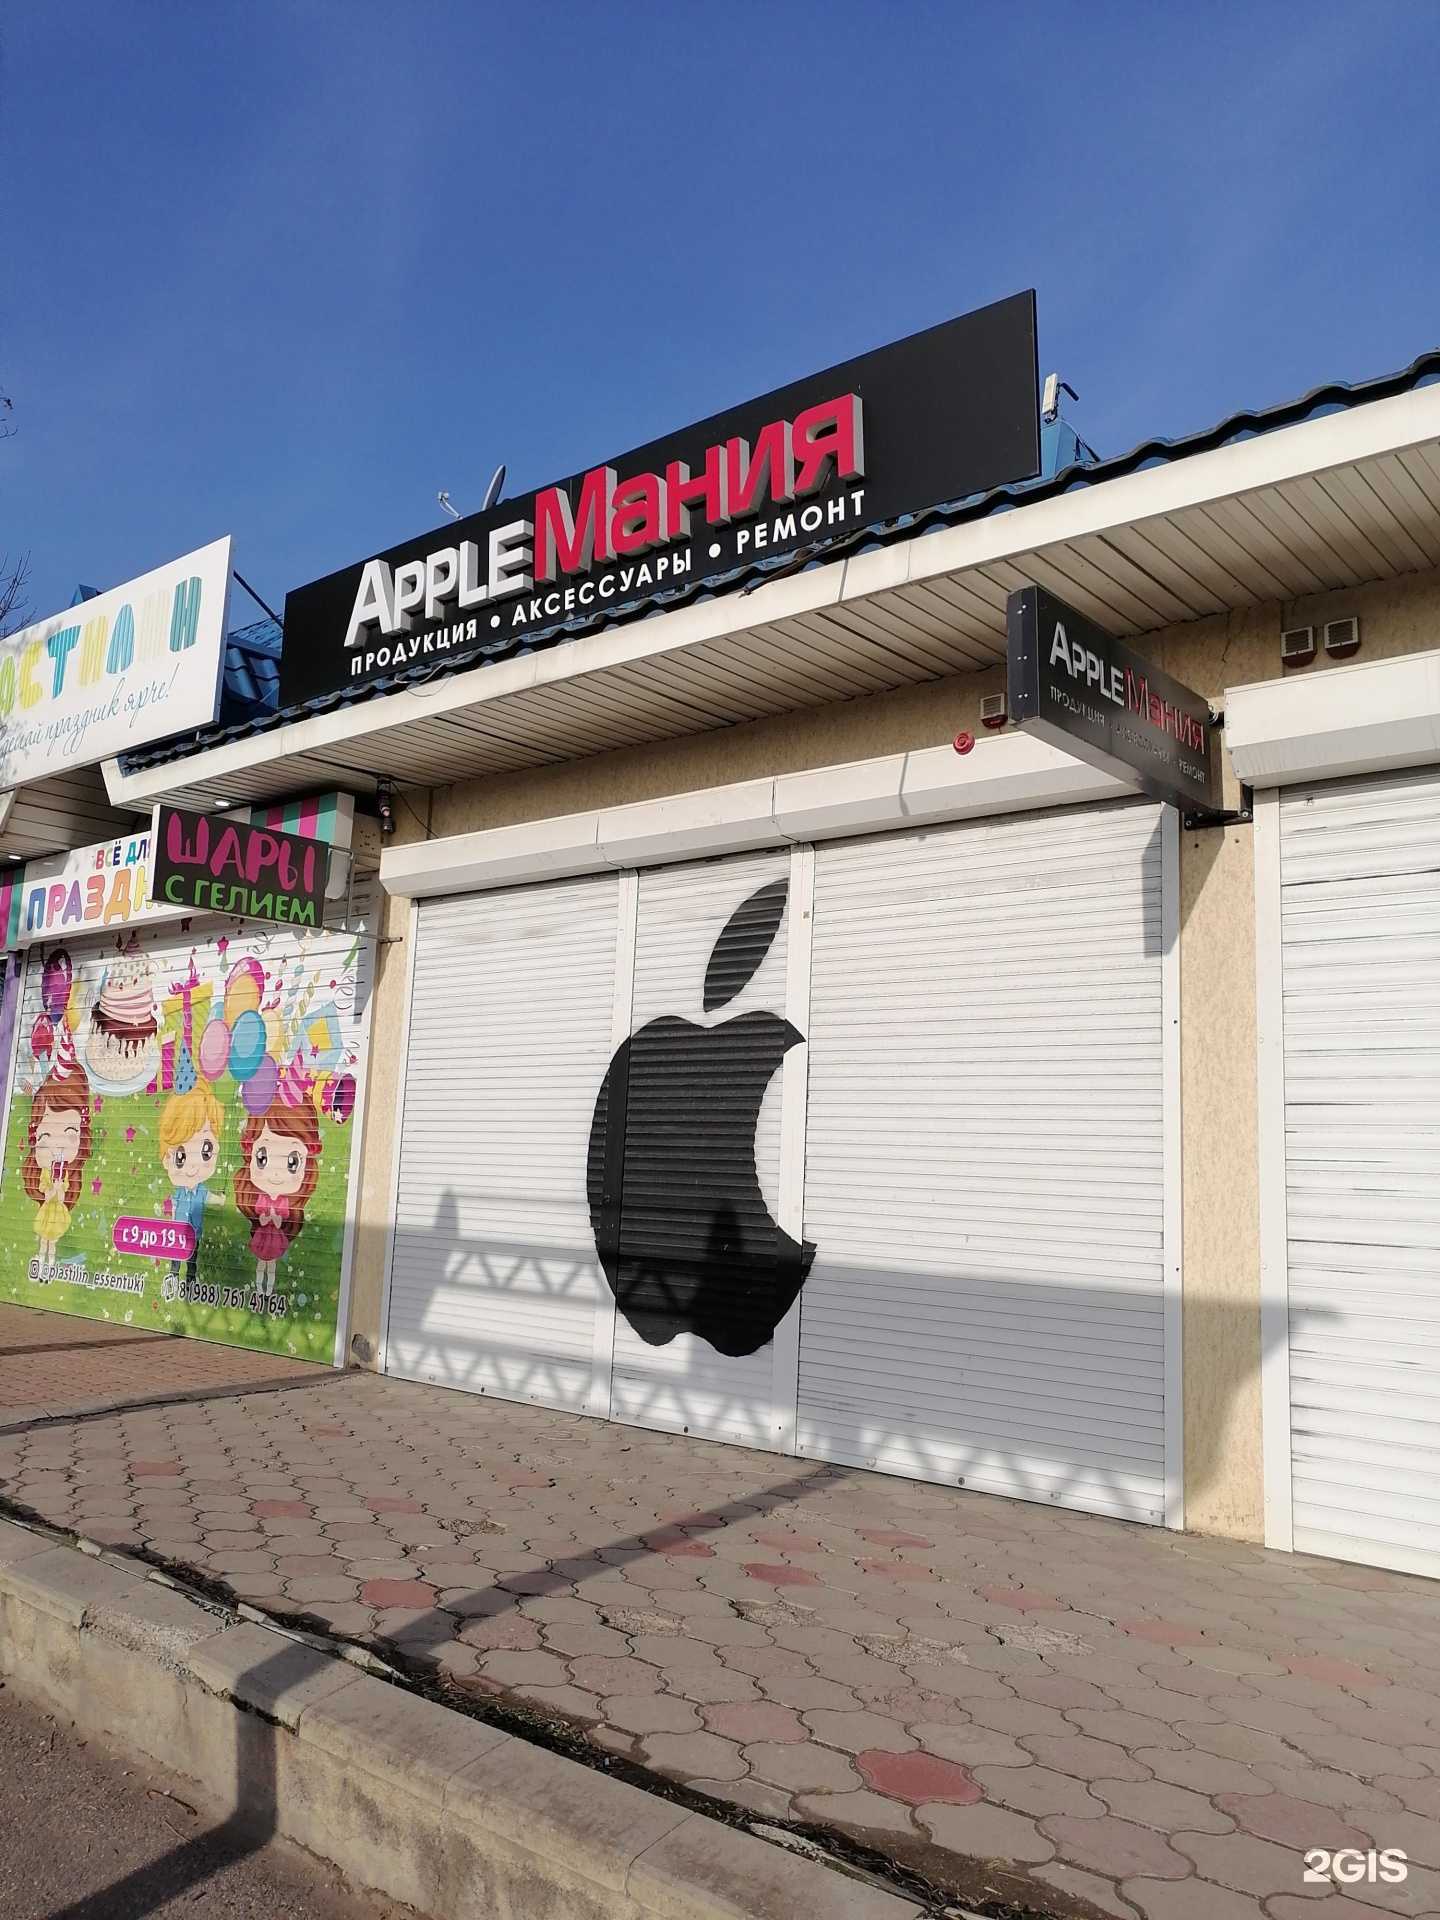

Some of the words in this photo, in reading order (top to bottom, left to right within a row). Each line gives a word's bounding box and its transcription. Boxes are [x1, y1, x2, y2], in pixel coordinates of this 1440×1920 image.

[350, 619, 478, 677] ПРОДУКЦИЯ
[510, 548, 692, 627] АКСЕССУАРЫ
[735, 489, 866, 555] РЕМОНТ
[123, 662, 180, 729] ярче!
[95, 841, 122, 870] ВСЁ
[166, 811, 316, 894] ШАРЫ
[165, 874, 185, 903] С
[194, 879, 316, 926] ГЕЛИЕМ
[122, 1228, 129, 1242] с
[131, 1225, 139, 1243] 9
[140, 1230, 157, 1249] до
[161, 1228, 176, 1248] 19
[189, 1281, 219, 1307] (988)
[223, 1288, 245, 1309] 761
[249, 1292, 264, 1312] 41
[269, 1295, 285, 1314] 64
